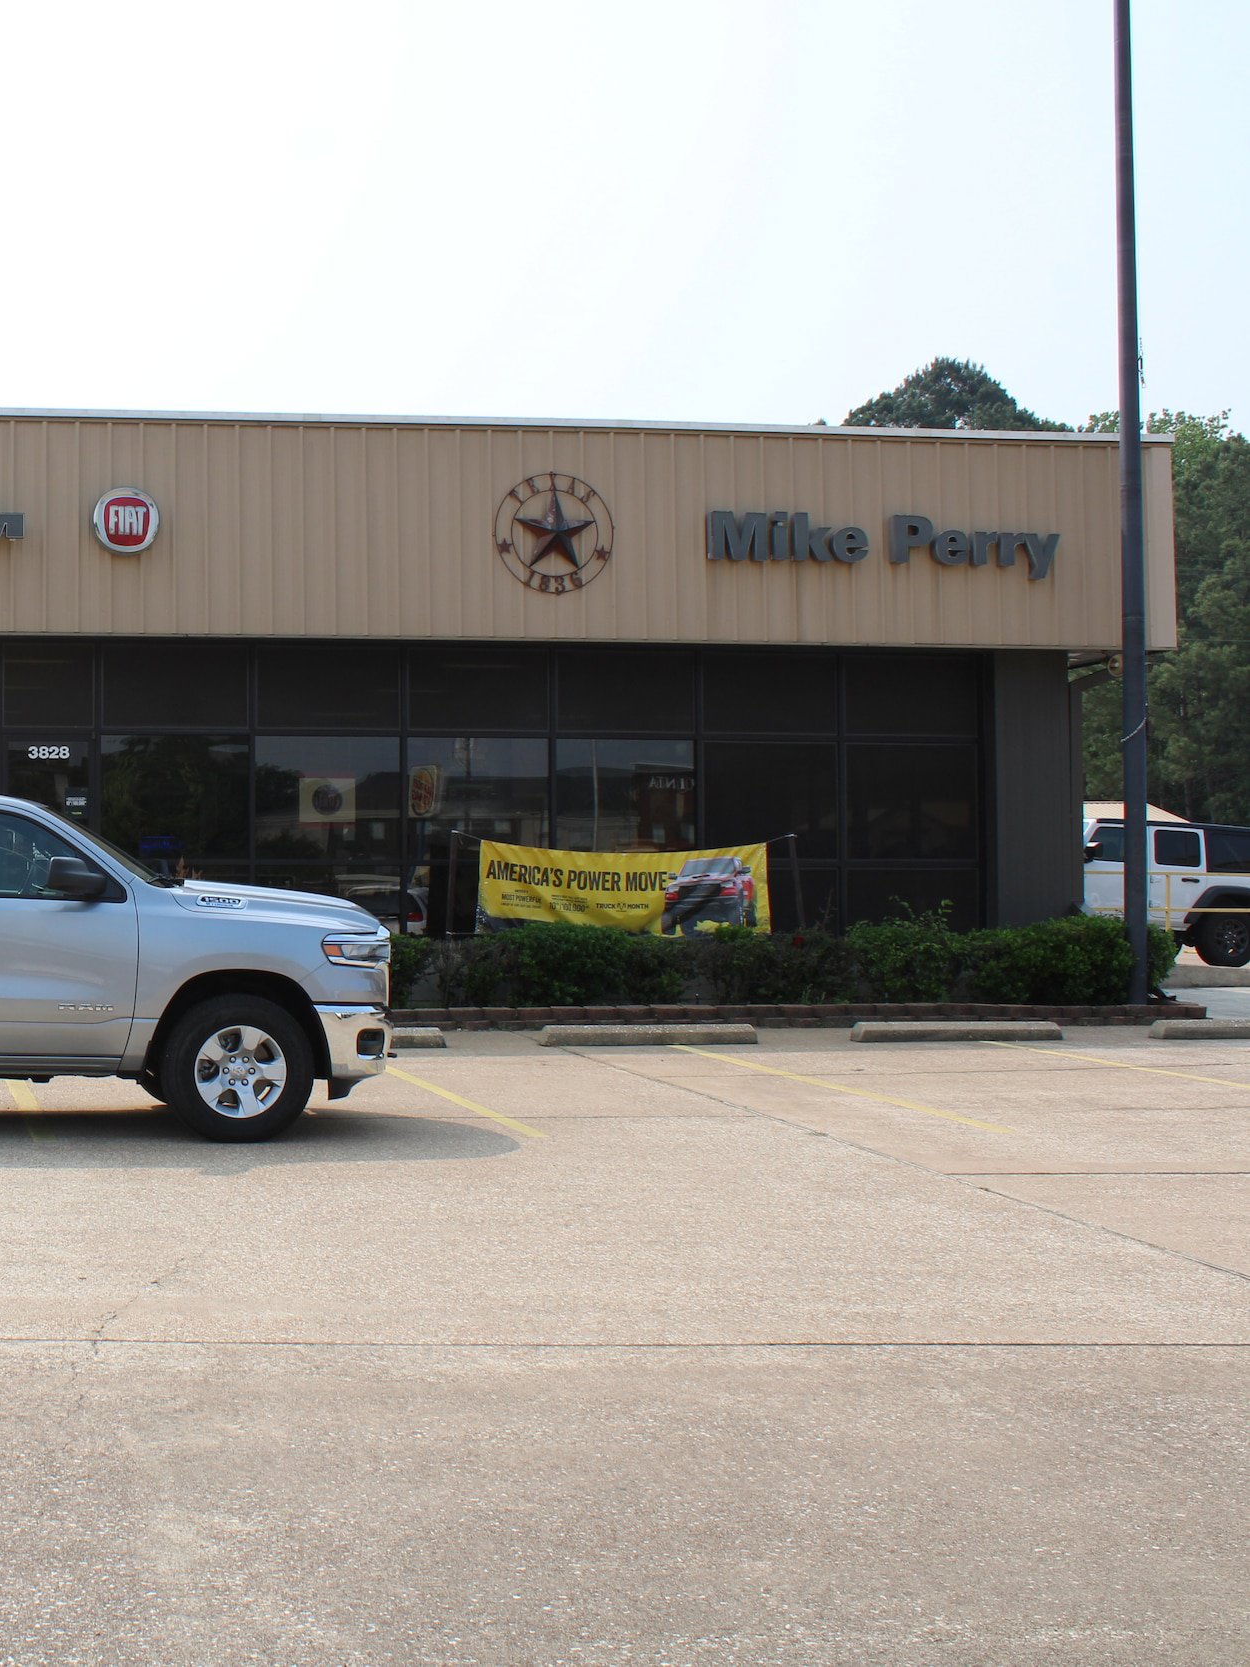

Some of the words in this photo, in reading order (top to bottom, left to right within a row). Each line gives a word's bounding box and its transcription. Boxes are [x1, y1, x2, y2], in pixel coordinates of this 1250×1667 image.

[109, 505, 147, 536] FIAT
[706, 510, 869, 562] Mike
[888, 514, 1061, 581] Perry
[523, 570, 583, 594] 1836
[27, 745, 71, 760] 3828
[486, 860, 563, 888] AMERICA'S
[567, 870, 621, 892] POWER
[625, 872, 666, 892] MOVE
[595, 902, 616, 910] TRUCK
[58, 1003, 114, 1011] RAM
